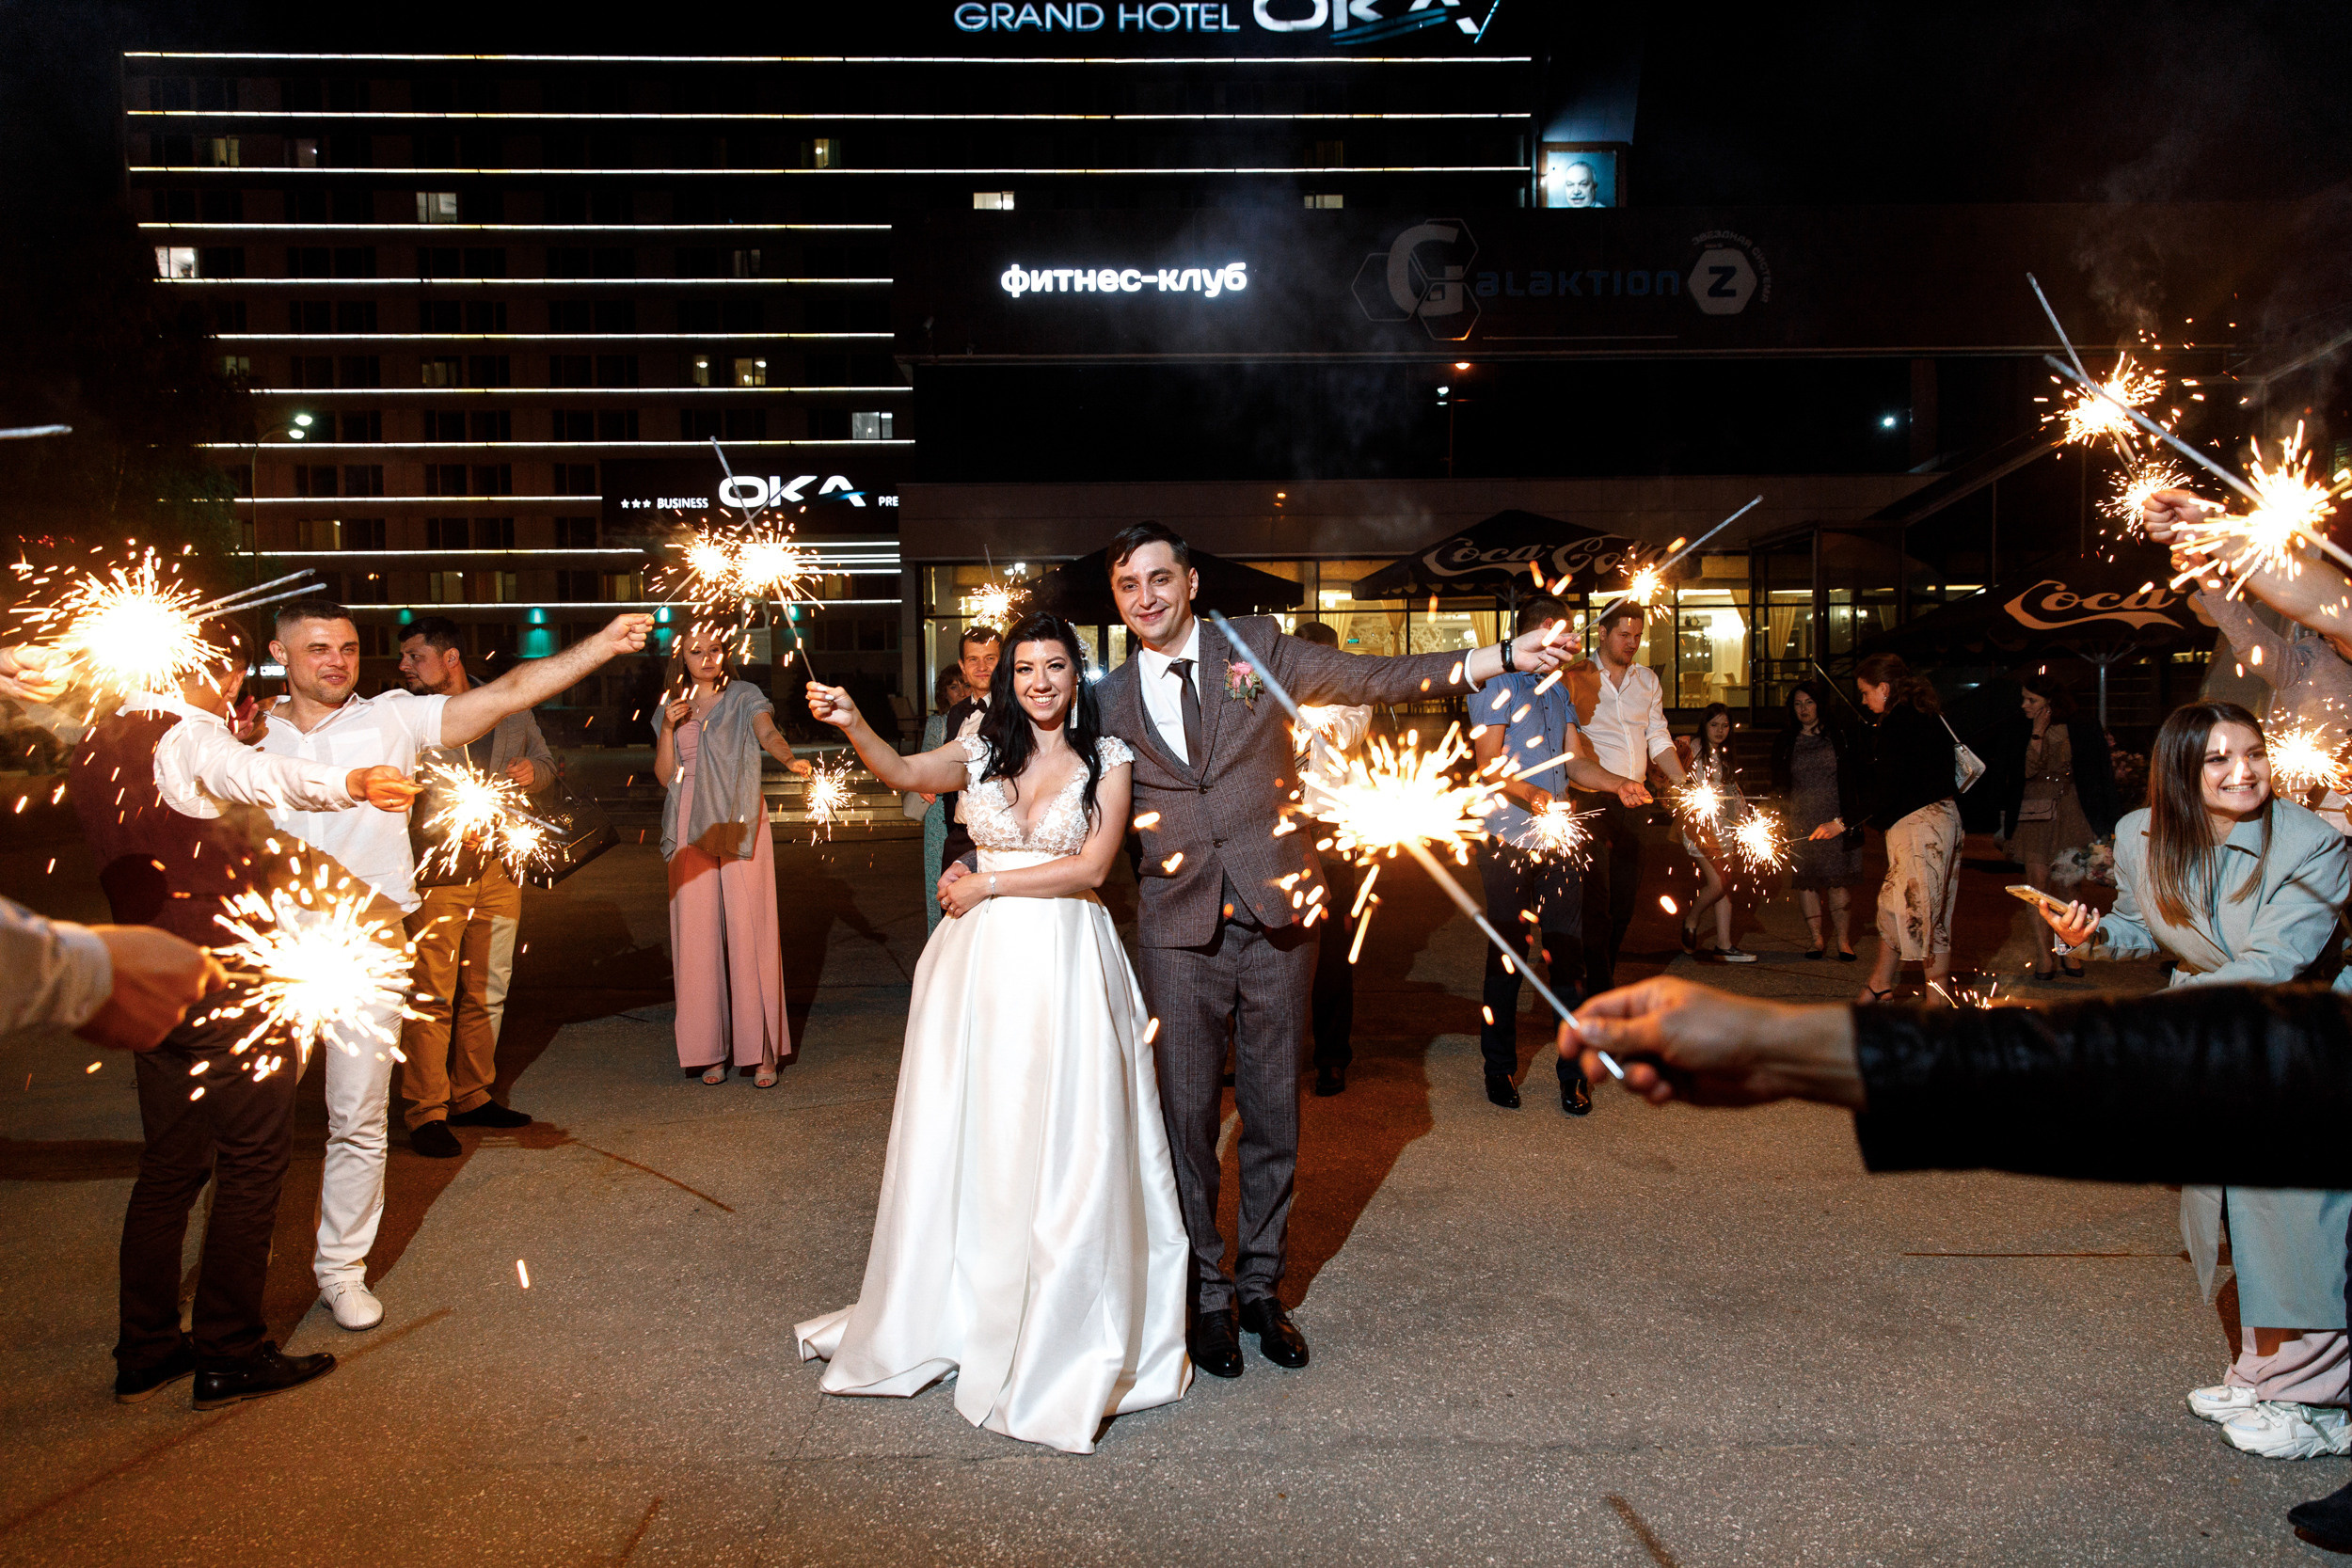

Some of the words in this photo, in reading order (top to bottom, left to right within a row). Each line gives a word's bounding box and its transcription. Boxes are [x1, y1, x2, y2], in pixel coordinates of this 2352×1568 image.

[953, 2, 1105, 32] GRAND
[1118, 2, 1241, 32] HOTEL
[1000, 263, 1248, 298] фитнес-клуб
[657, 498, 709, 509] BUSINESS
